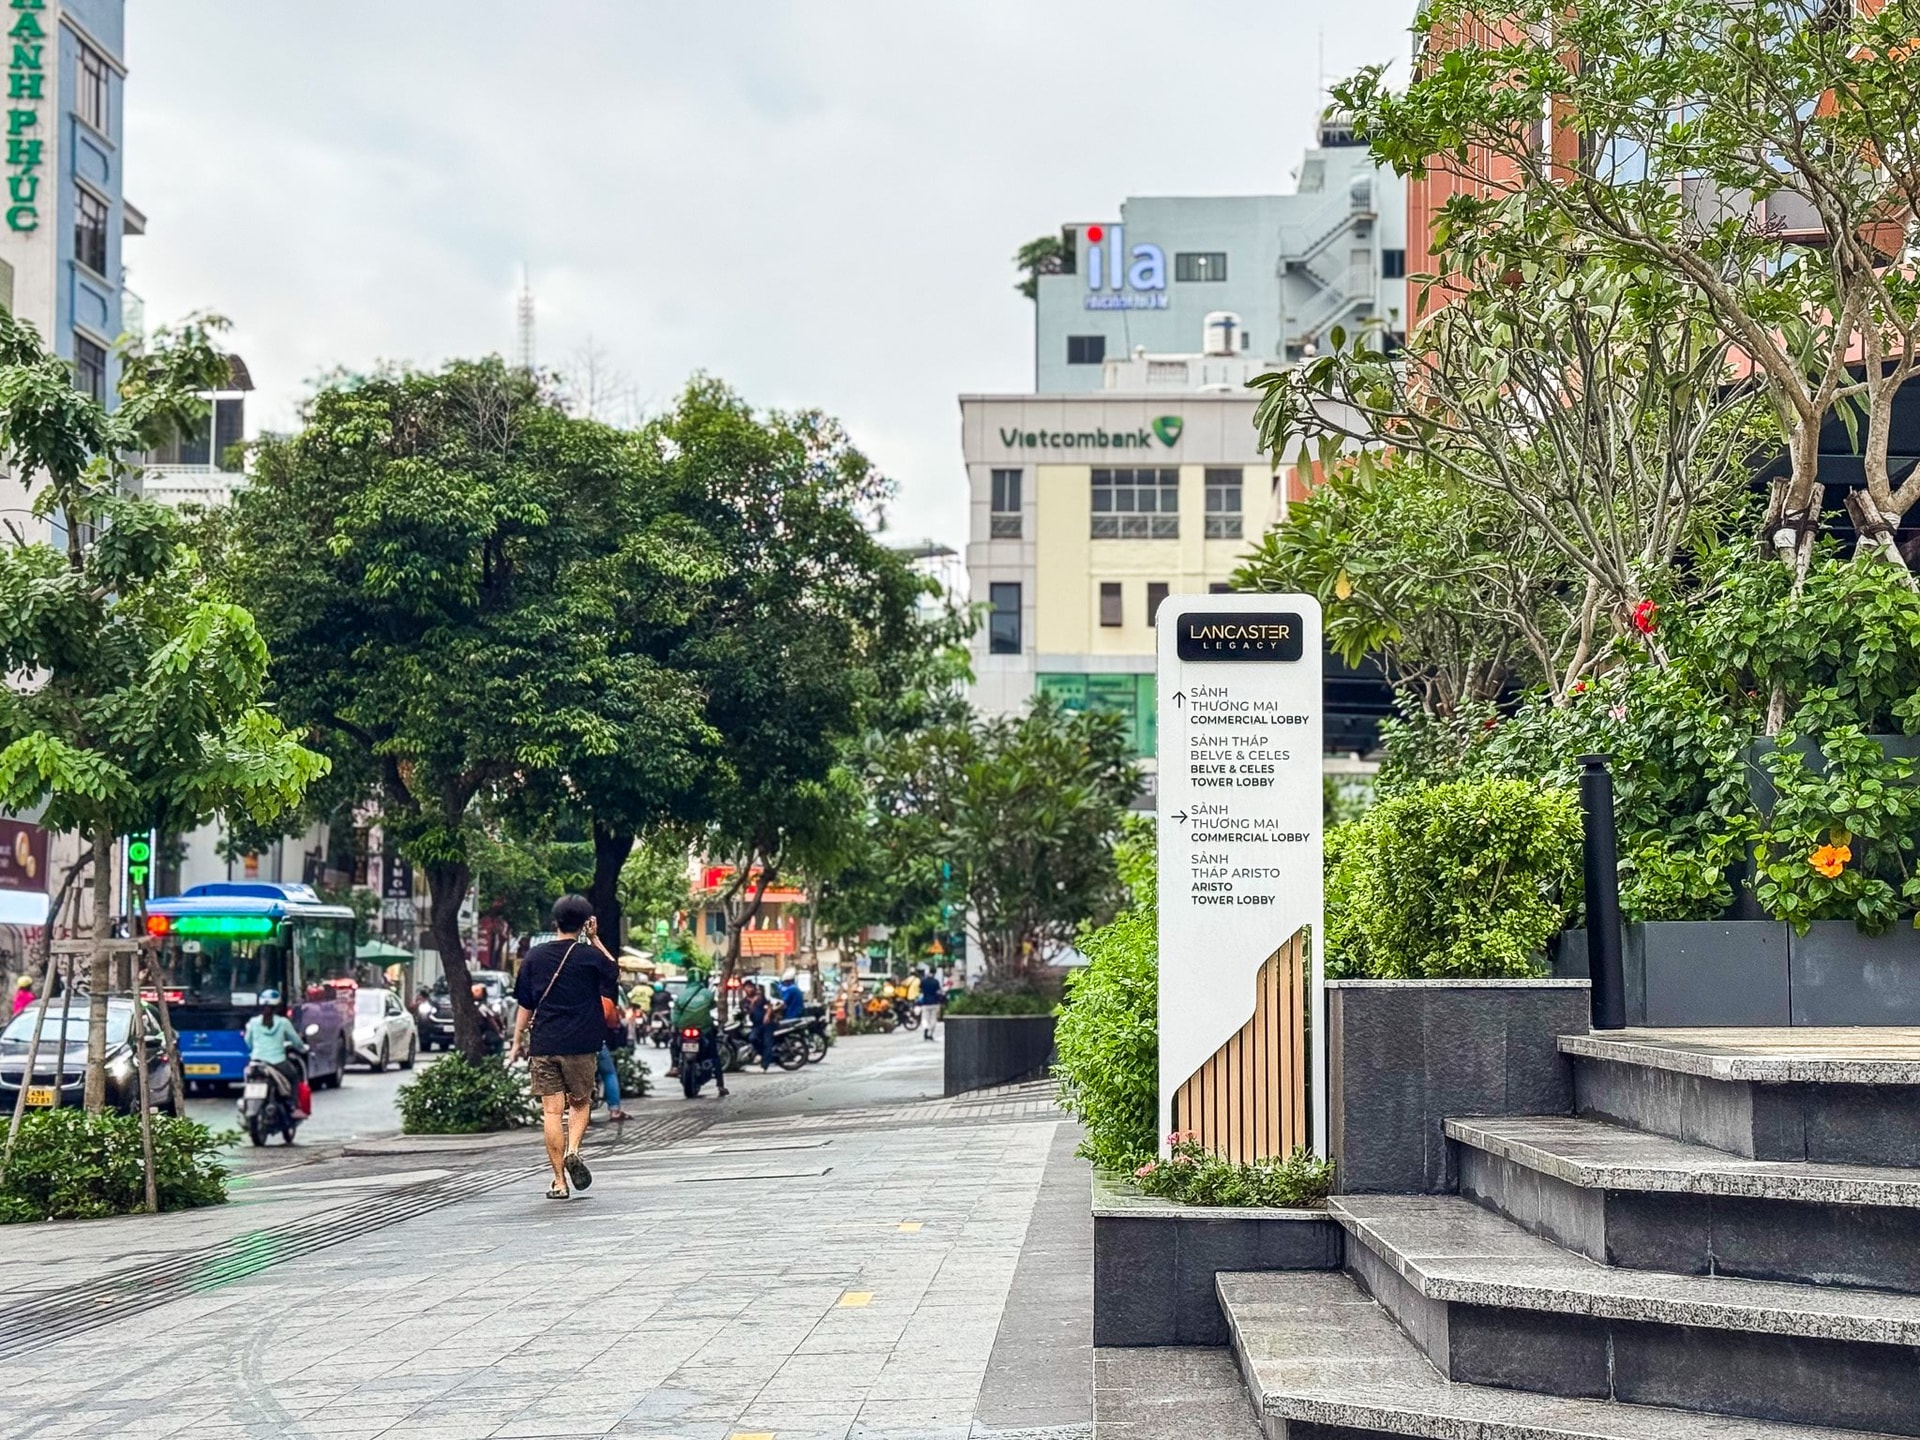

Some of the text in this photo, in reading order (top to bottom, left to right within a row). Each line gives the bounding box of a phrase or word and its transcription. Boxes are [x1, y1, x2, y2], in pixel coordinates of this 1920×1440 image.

[6, 109, 43, 231] PHÚC
[1087, 225, 1166, 291] ila
[1000, 427, 1152, 448] Vietcombank
[1191, 625, 1289, 639] LANCASTER
[1191, 700, 1277, 713] THƯƠNG MẠI
[1191, 716, 1309, 724] COMMERCIAL LOBBY
[1232, 735, 1268, 746] THÁP
[1191, 751, 1289, 760] BELVE & CELES
[1191, 765, 1274, 773] BELVE & CELES
[1191, 778, 1274, 787] TOWER LOBBY
[1191, 817, 1278, 831] THƯƠNG MẠI
[1191, 833, 1310, 842] COMMERCIAL LOBBY
[1192, 866, 1280, 878] THÁP ARISTO
[1192, 882, 1232, 891] ARISTO
[1191, 896, 1275, 905] TOWER LOBBY
